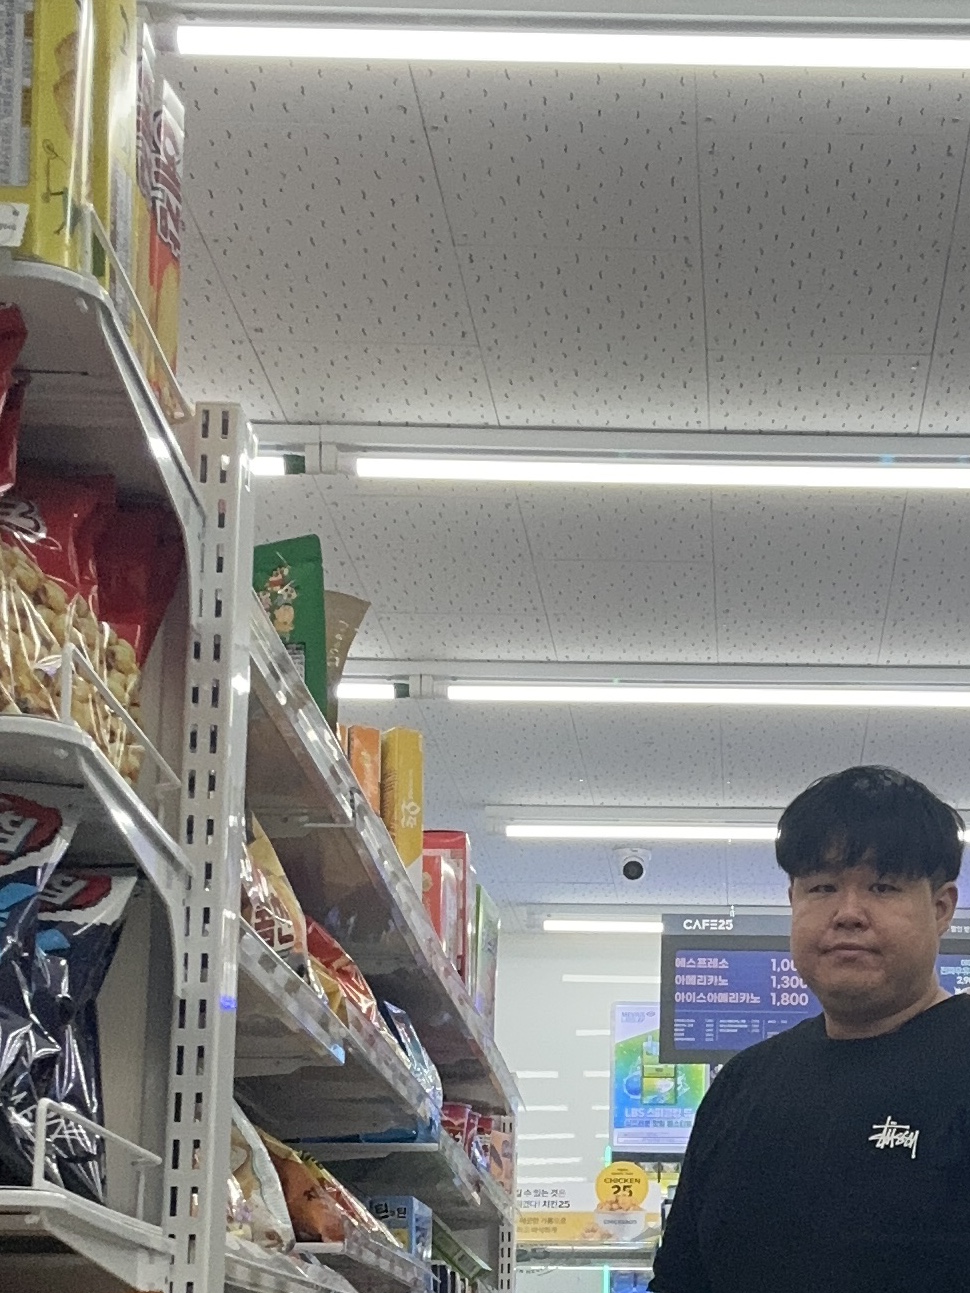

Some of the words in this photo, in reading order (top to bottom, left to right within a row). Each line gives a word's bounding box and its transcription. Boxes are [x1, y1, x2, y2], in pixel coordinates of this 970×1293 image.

[683, 919, 734, 931] CAFE25
[674, 957, 729, 969] 에스프레소
[674, 974, 729, 986] 아메리카노
[674, 992, 761, 1004] 아이스아메리카노
[770, 993, 809, 1007] 1,800
[603, 1177, 641, 1185] CHICKEN
[611, 1184, 634, 1198] 25
